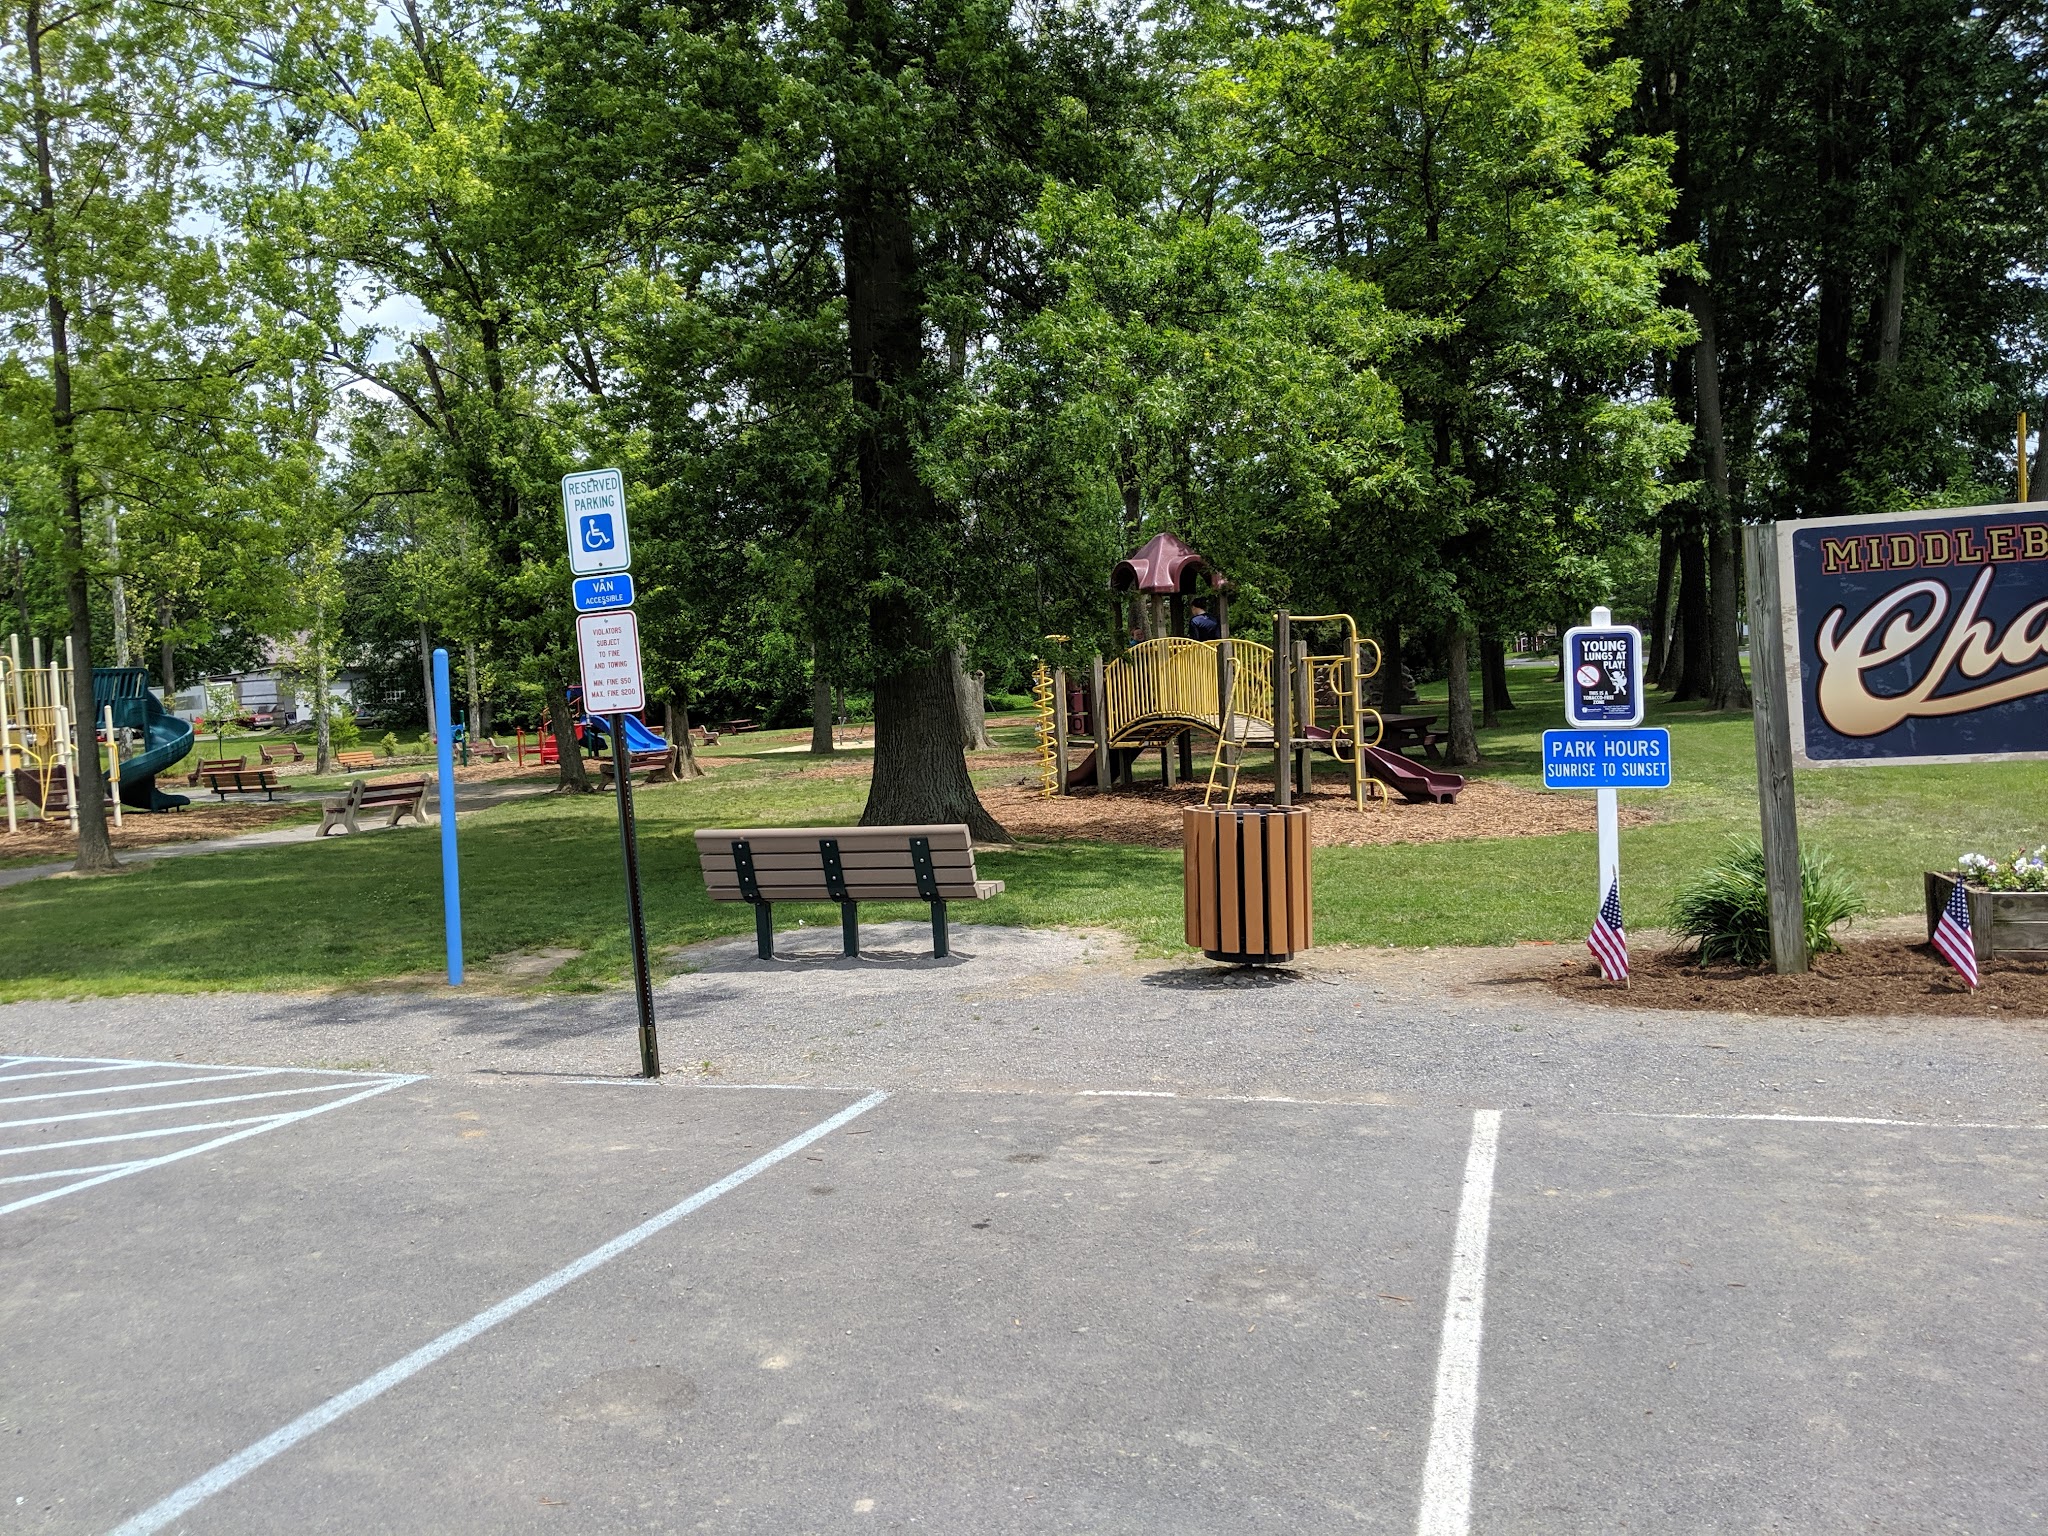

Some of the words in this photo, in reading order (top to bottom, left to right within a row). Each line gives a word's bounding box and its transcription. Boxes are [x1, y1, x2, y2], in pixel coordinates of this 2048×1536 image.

[568, 477, 618, 495] RESERVED
[574, 495, 615, 511] PARKING
[1821, 522, 2048, 575] MIDDLEB
[593, 581, 614, 593] VAN
[585, 594, 623, 605] ACCESSIBLE
[592, 627, 622, 636] VIOLATORS
[596, 638, 620, 647] SUBJECT
[1582, 640, 1627, 652] YOUNG
[1584, 652, 1613, 661] LUNGS
[1616, 651, 1627, 660] AT
[608, 660, 628, 669] TOWING
[1603, 660, 1626, 669] PLAY!
[593, 679, 605, 687] MIN.
[606, 678, 619, 686] FINE
[620, 677, 632, 685] $50
[591, 690, 606, 698] MAX.
[607, 689, 620, 697] FINE
[620, 688, 636, 696] $200
[1552, 740, 1597, 758] PARK
[1604, 740, 1660, 757] HOURS
[1547, 763, 1596, 777] SUNRISE
[1602, 762, 1616, 776] TO
[1621, 762, 1666, 777] SUNSET
